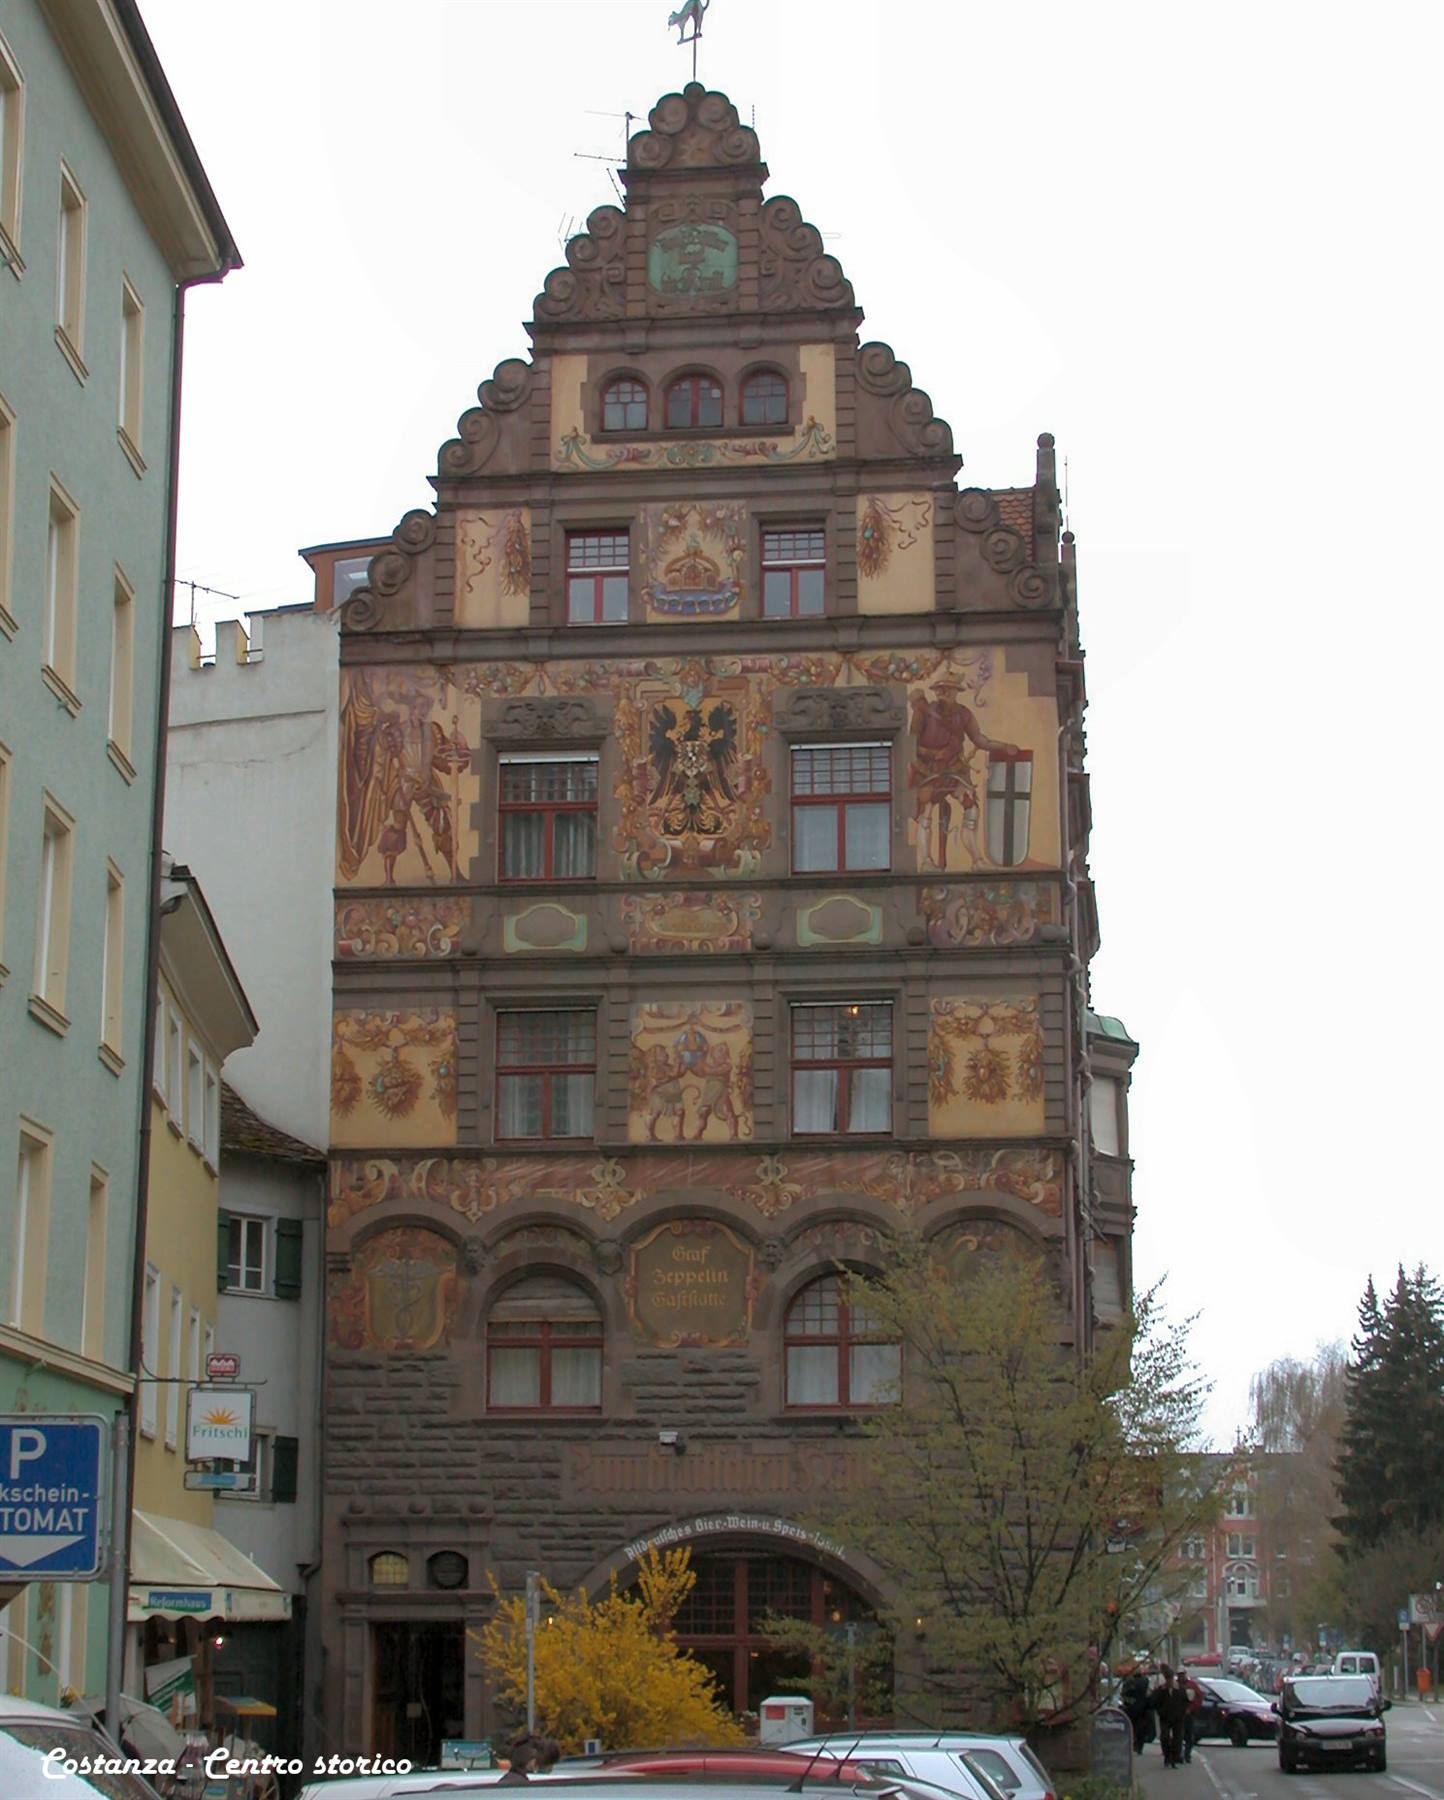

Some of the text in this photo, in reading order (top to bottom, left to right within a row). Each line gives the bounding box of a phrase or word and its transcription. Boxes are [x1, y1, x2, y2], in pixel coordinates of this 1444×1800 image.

[672, 1246, 710, 1264] Graf
[653, 1268, 729, 1286] Zeppelin
[192, 1425, 249, 1439] Fritschi
[10, 1428, 47, 1480] P
